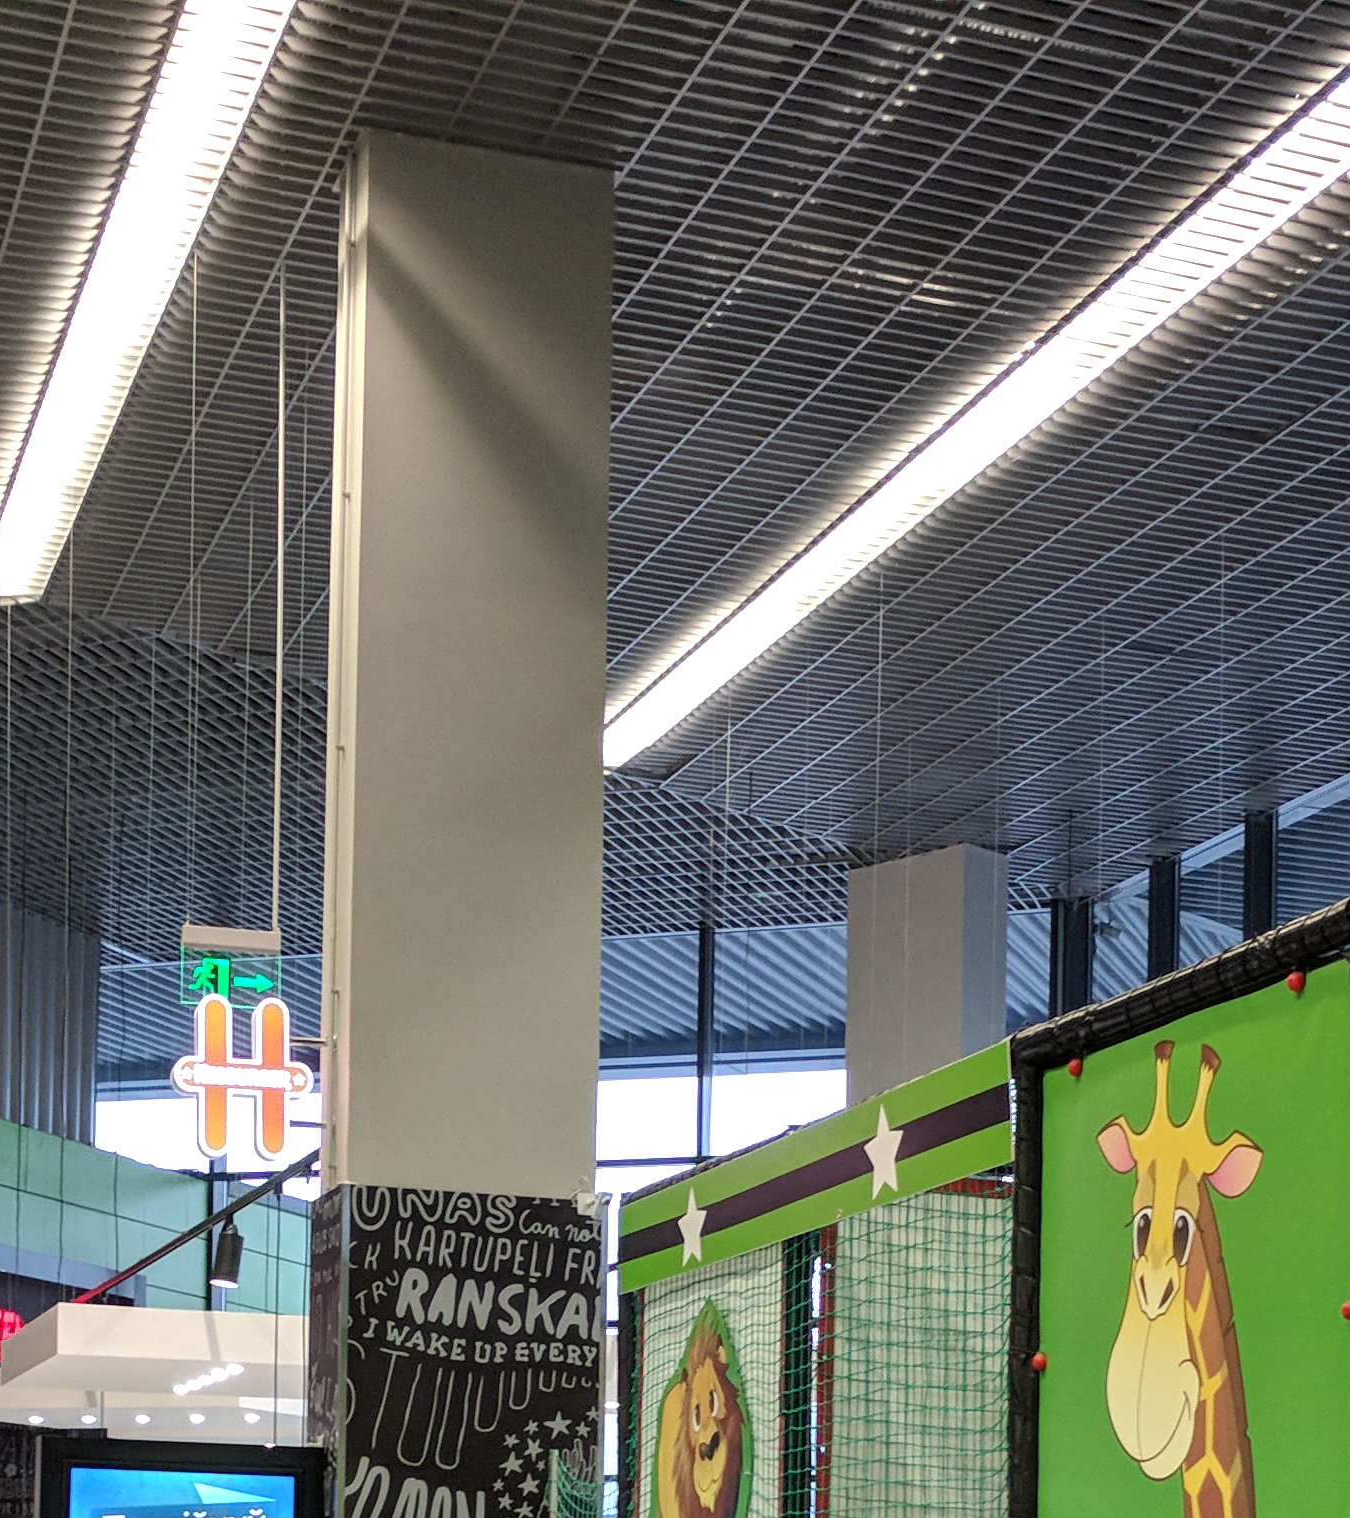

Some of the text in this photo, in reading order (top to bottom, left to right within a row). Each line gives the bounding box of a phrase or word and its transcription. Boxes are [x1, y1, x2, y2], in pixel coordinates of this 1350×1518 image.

[564, 1247, 601, 1290] FR
[386, 1320, 466, 1361] WAKE
[475, 1341, 509, 1364] UP
[516, 1342, 597, 1368] EVERY
